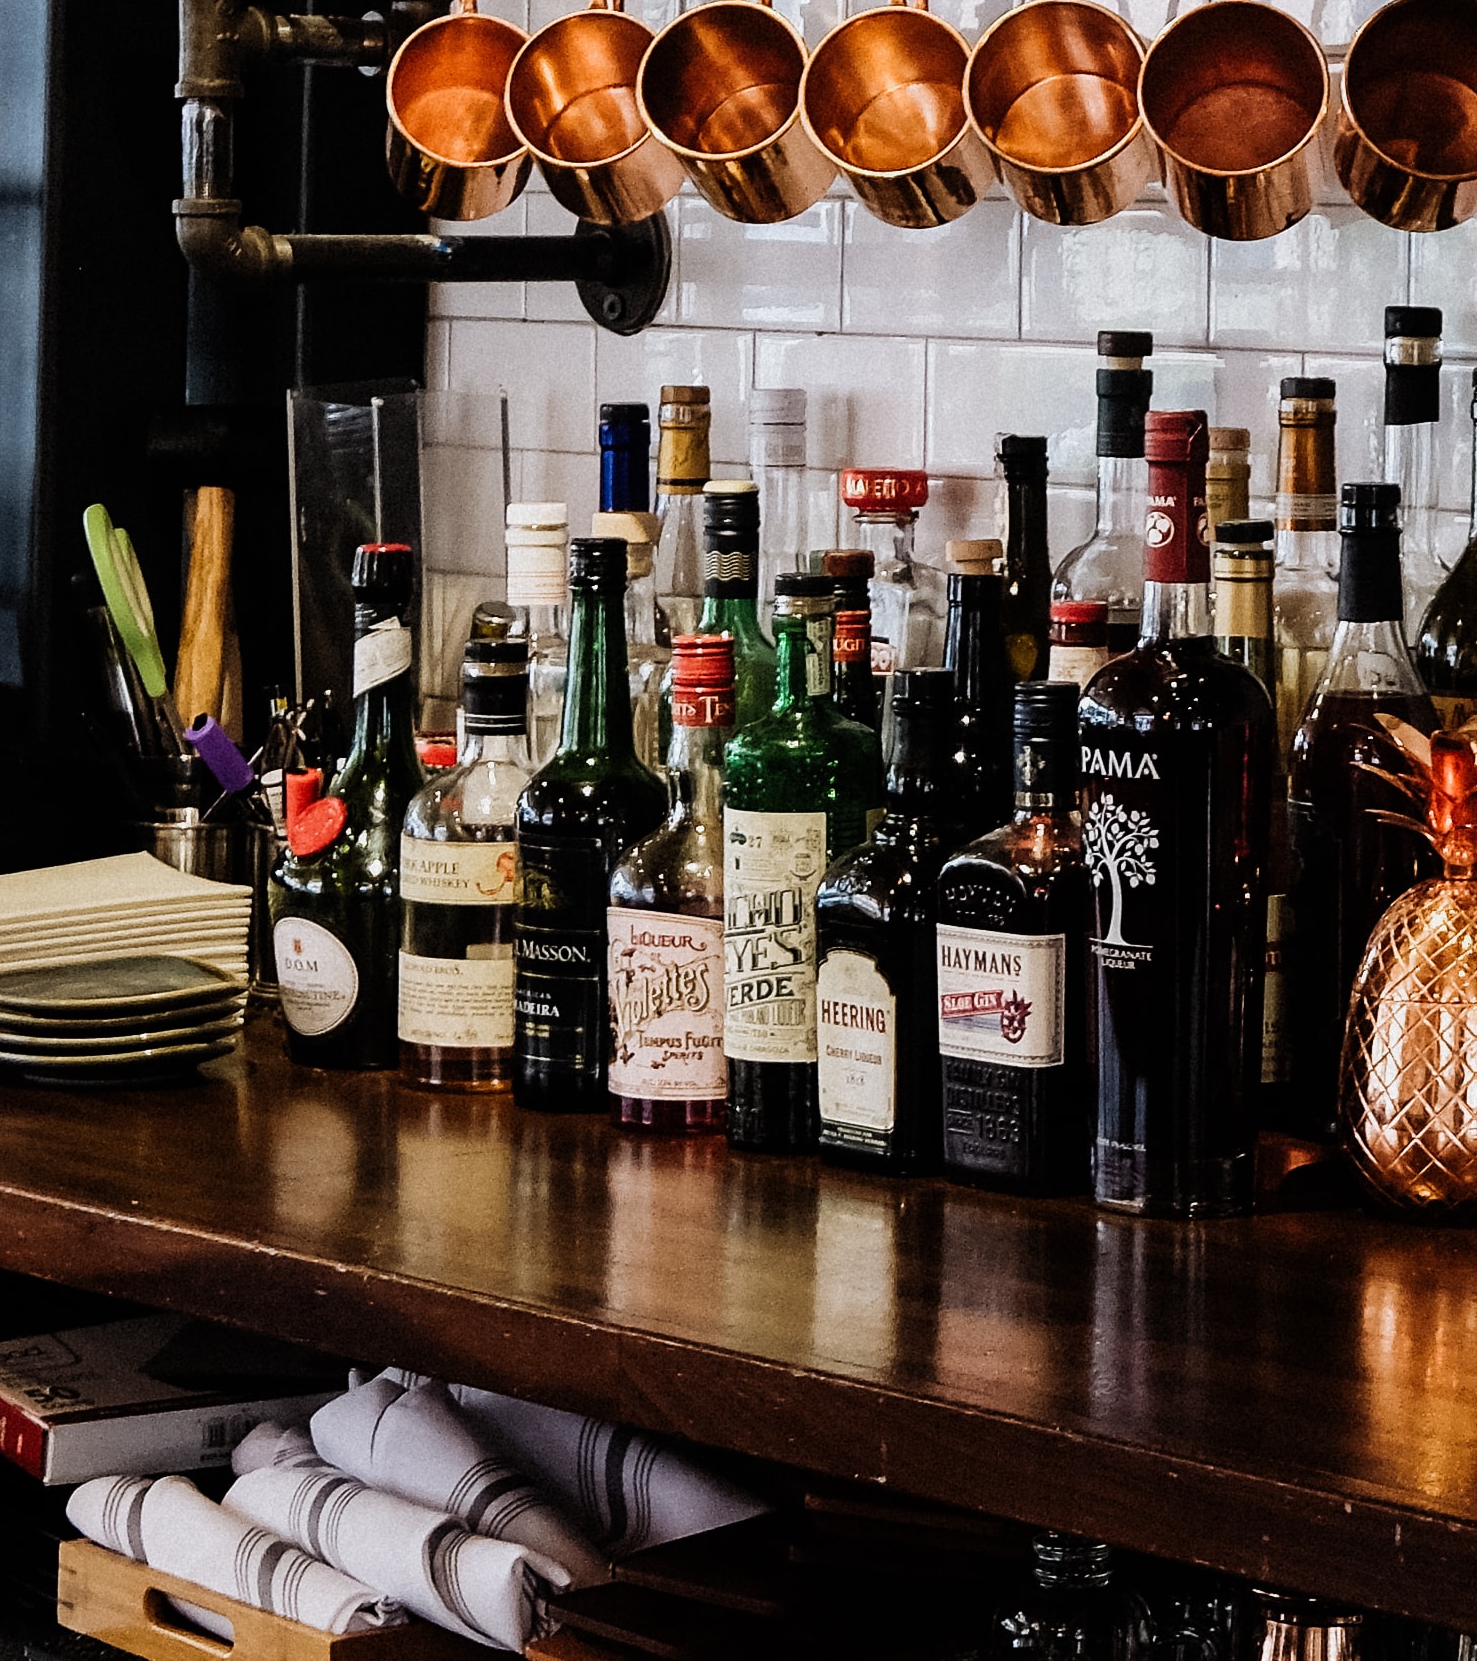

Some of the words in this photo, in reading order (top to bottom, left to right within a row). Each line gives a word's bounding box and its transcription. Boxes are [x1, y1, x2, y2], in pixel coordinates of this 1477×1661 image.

[1146, 495, 1177, 508] AMA
[1080, 745, 1161, 780] PAMA
[418, 860, 460, 876] APPLE
[420, 876, 471, 890] WHISKEY
[1090, 944, 1154, 963] POMEGRANATE
[1101, 957, 1137, 972] LIQUEUR
[727, 975, 796, 1007] ERDE
[943, 993, 973, 1011] SLOE
[973, 990, 1002, 1009] GIN
[820, 999, 888, 1035] HEERING
[825, 1044, 853, 1061] CHERRY
[853, 1049, 883, 1067] LIQUEUR
